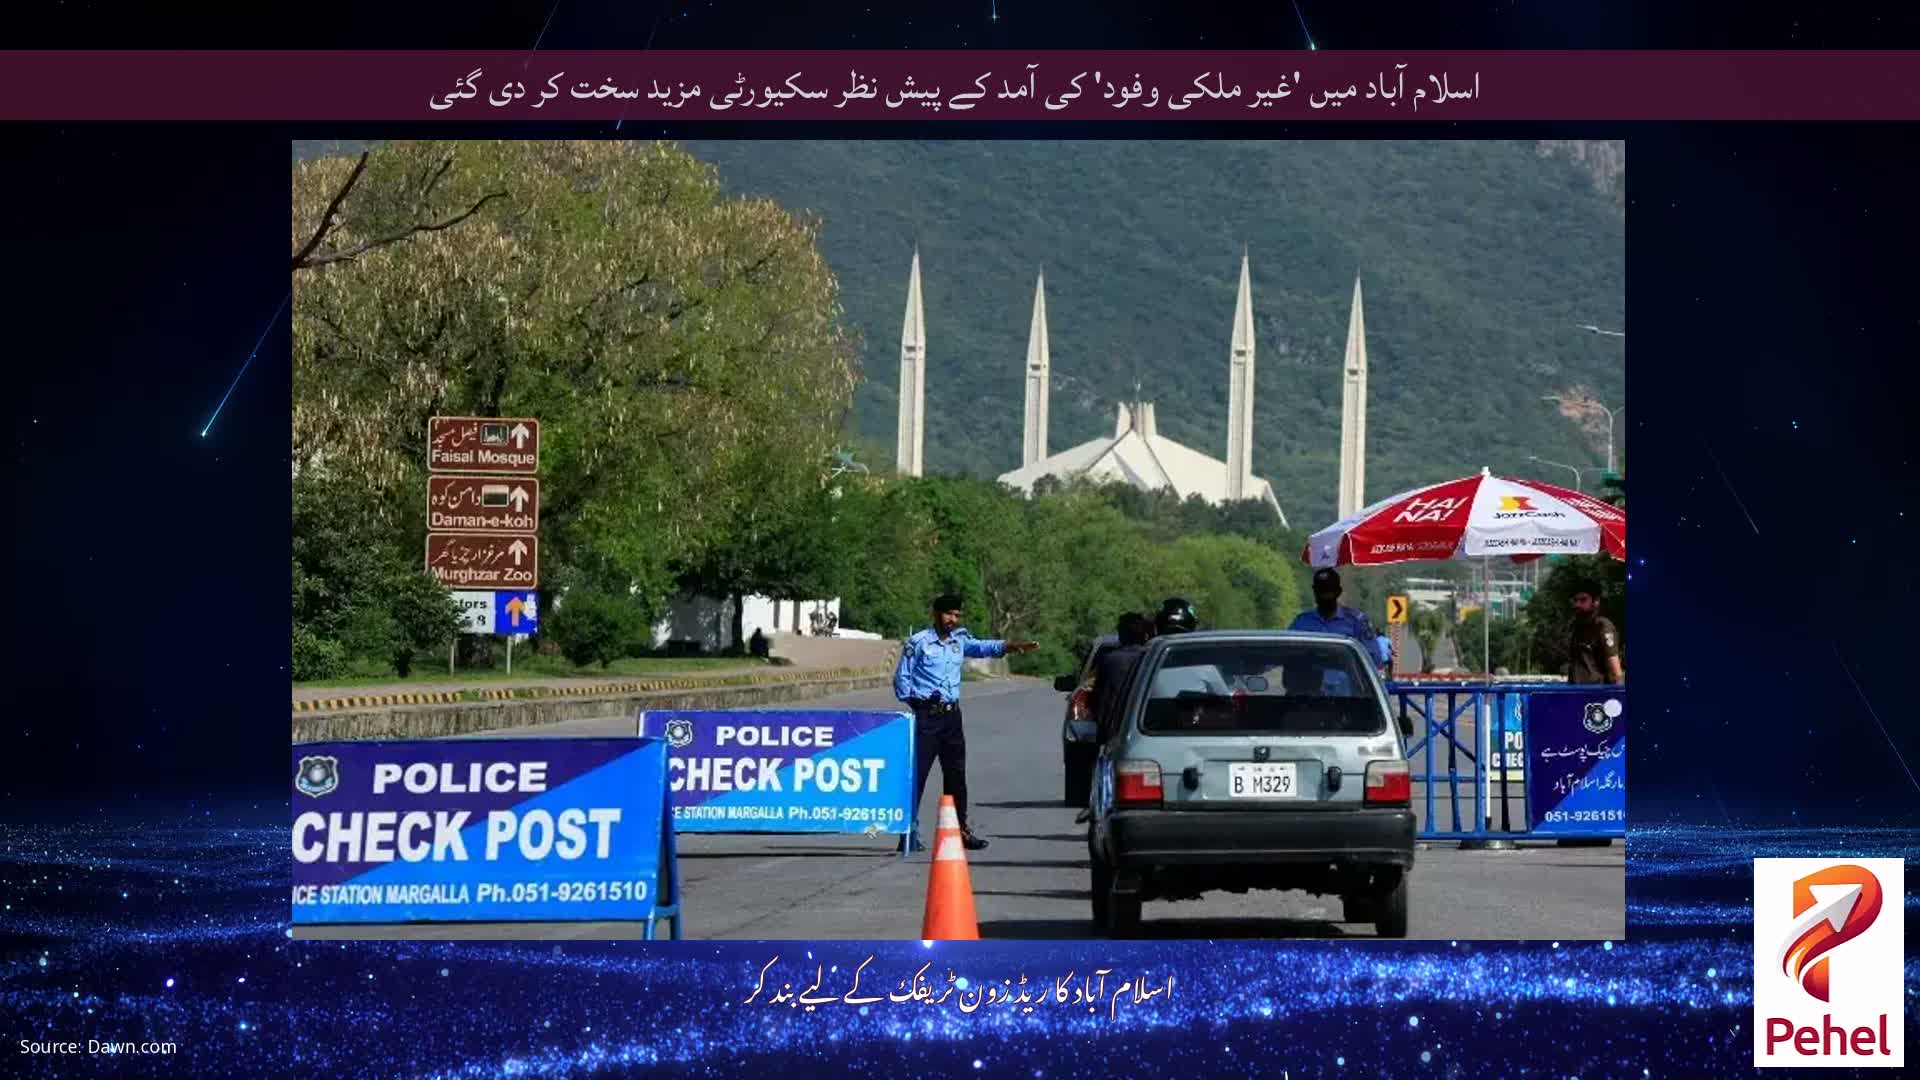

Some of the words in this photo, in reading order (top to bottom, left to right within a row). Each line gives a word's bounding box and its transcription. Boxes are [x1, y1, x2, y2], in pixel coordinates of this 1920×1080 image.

[432, 449, 473, 463] Faisal
[478, 450, 535, 467] Mosque
[431, 511, 534, 528] Daman-e-koh
[1392, 509, 1455, 523] NA!
[432, 566, 501, 584] Murghzar
[503, 567, 533, 581] Zoo
[715, 725, 834, 746] POLICE
[372, 762, 548, 794] POLICE
[669, 756, 784, 792] CHECK
[793, 758, 886, 792] POST
[1234, 776, 1244, 793] B
[1252, 776, 1291, 793] M329
[684, 806, 726, 820] STATION
[727, 806, 784, 820] MARGALLA
[788, 806, 904, 822] Ph.051-9261510
[1544, 810, 1625, 822] 051-926151
[291, 811, 471, 863] CHECK
[485, 808, 622, 861] POST
[320, 884, 383, 904] STATION
[385, 884, 469, 904] MARGALLA
[476, 881, 647, 903] Ph.051-9261510
